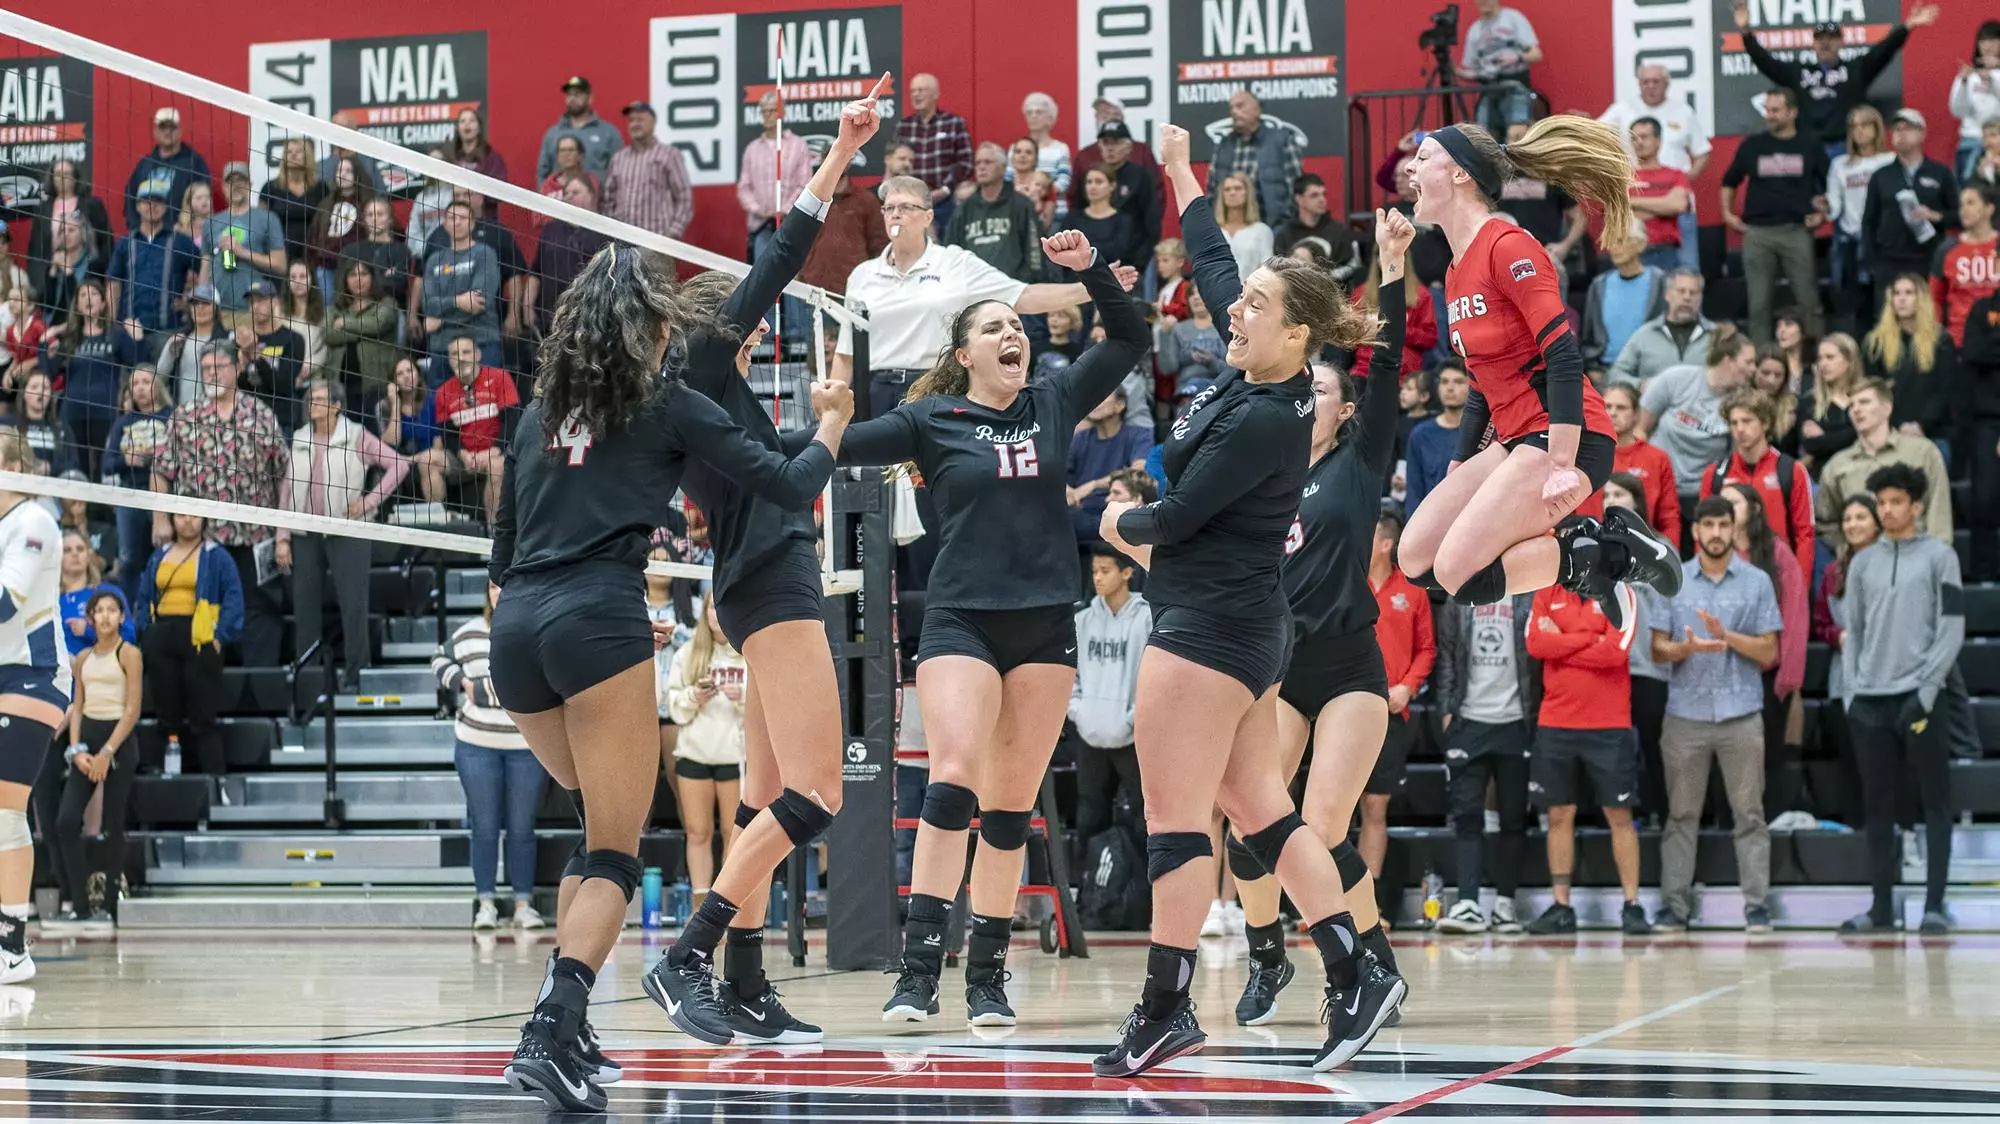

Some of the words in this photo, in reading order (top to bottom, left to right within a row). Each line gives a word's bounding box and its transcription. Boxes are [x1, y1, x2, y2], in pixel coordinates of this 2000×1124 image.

[1203, 0, 1312, 57] NAIA
[768, 18, 872, 81] NAIA
[360, 43, 459, 104] NAIA
[1228, 60, 1270, 77] CROSS
[1272, 56, 1330, 76] COUNTRY
[668, 28, 721, 171] 2001
[781, 80, 863, 100] WRESTLING
[1251, 77, 1339, 100] CHAMPIONS
[368, 103, 451, 125] WRESTLING
[974, 421, 1041, 443] Raiders
[993, 437, 1039, 479] 12
